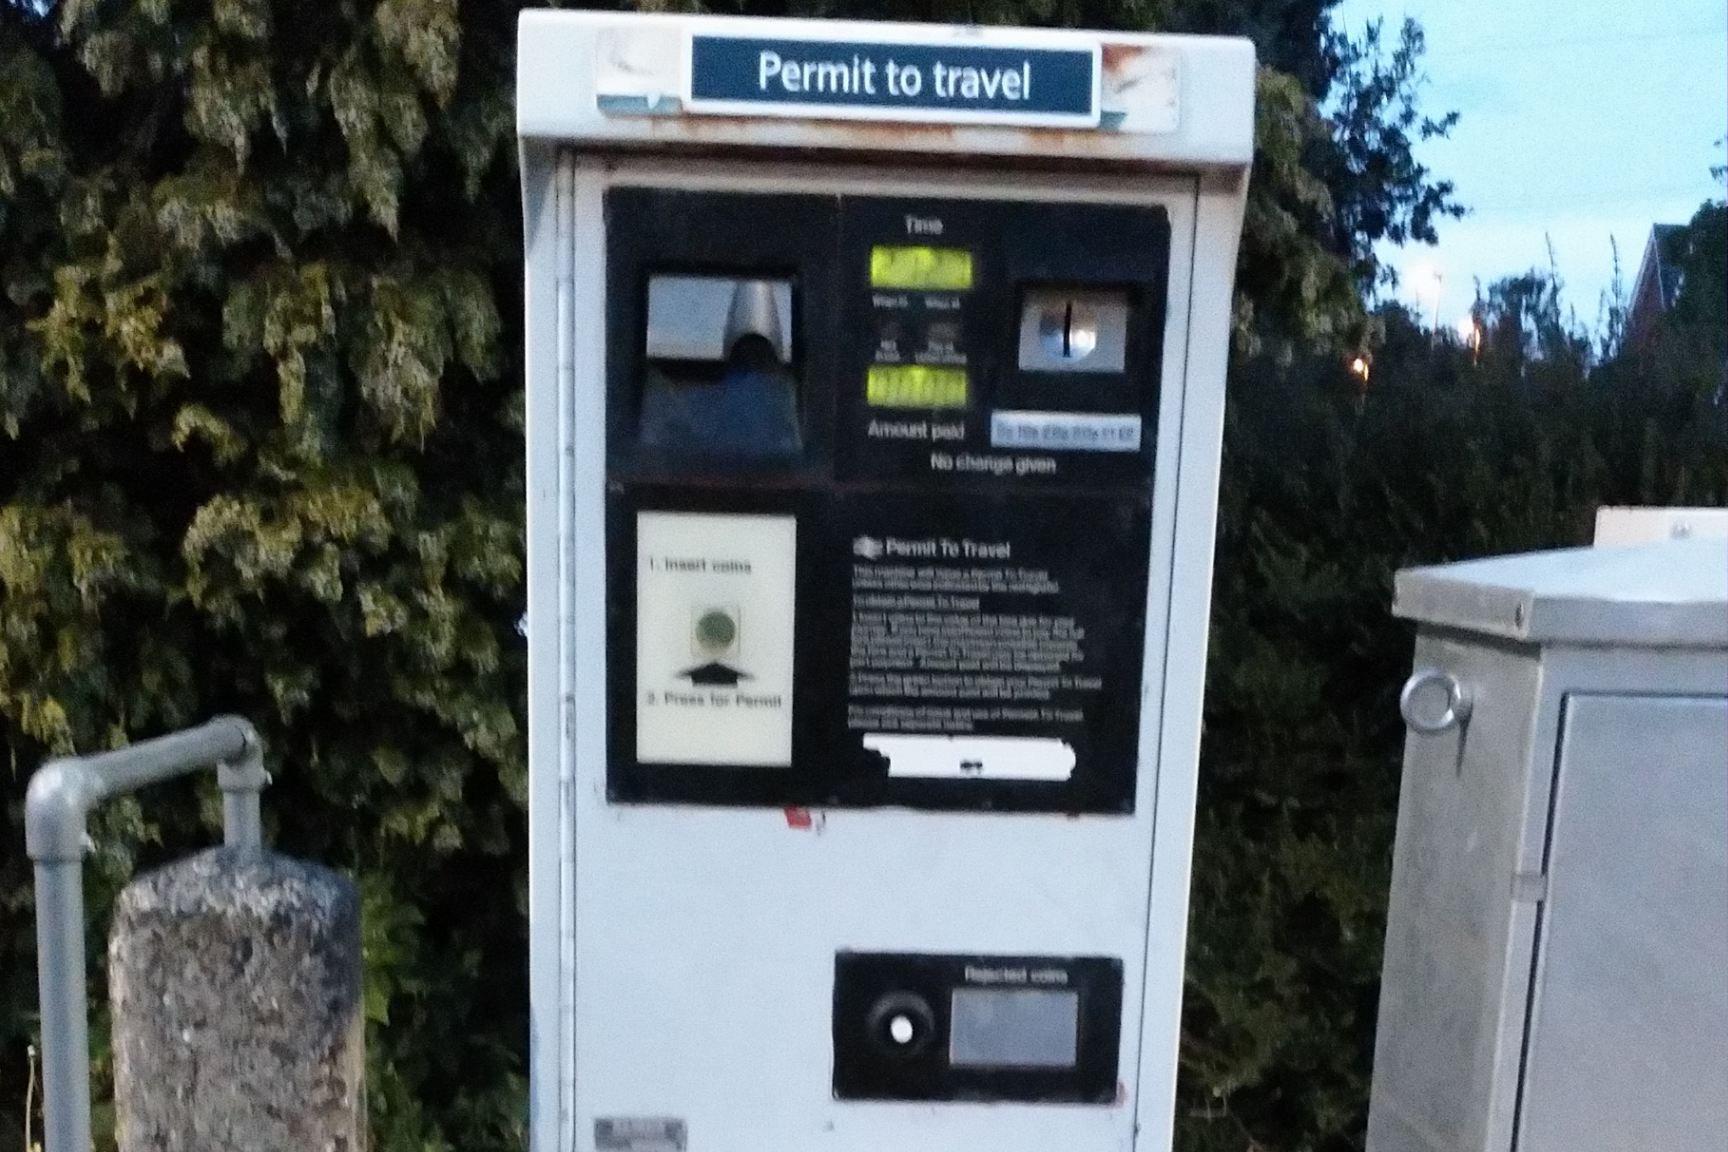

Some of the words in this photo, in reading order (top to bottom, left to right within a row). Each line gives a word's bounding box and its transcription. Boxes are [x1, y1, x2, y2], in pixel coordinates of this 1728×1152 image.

[758, 51, 875, 95] Permit
[886, 58, 921, 96] to
[934, 60, 1030, 100] travel
[906, 215, 943, 234] Time
[868, 419, 927, 440] Amount
[932, 423, 965, 442] paid
[931, 453, 952, 470] No
[956, 455, 1013, 474] change
[1016, 456, 1056, 475] given
[886, 538, 936, 556] Permit
[962, 539, 1010, 559] Travel
[664, 557, 706, 572] Insert
[713, 559, 752, 574] coins
[664, 693, 704, 707] Press
[711, 694, 729, 708] for
[736, 695, 782, 709] Permit
[965, 965, 1026, 984] Rejected
[1031, 967, 1068, 985] coins
